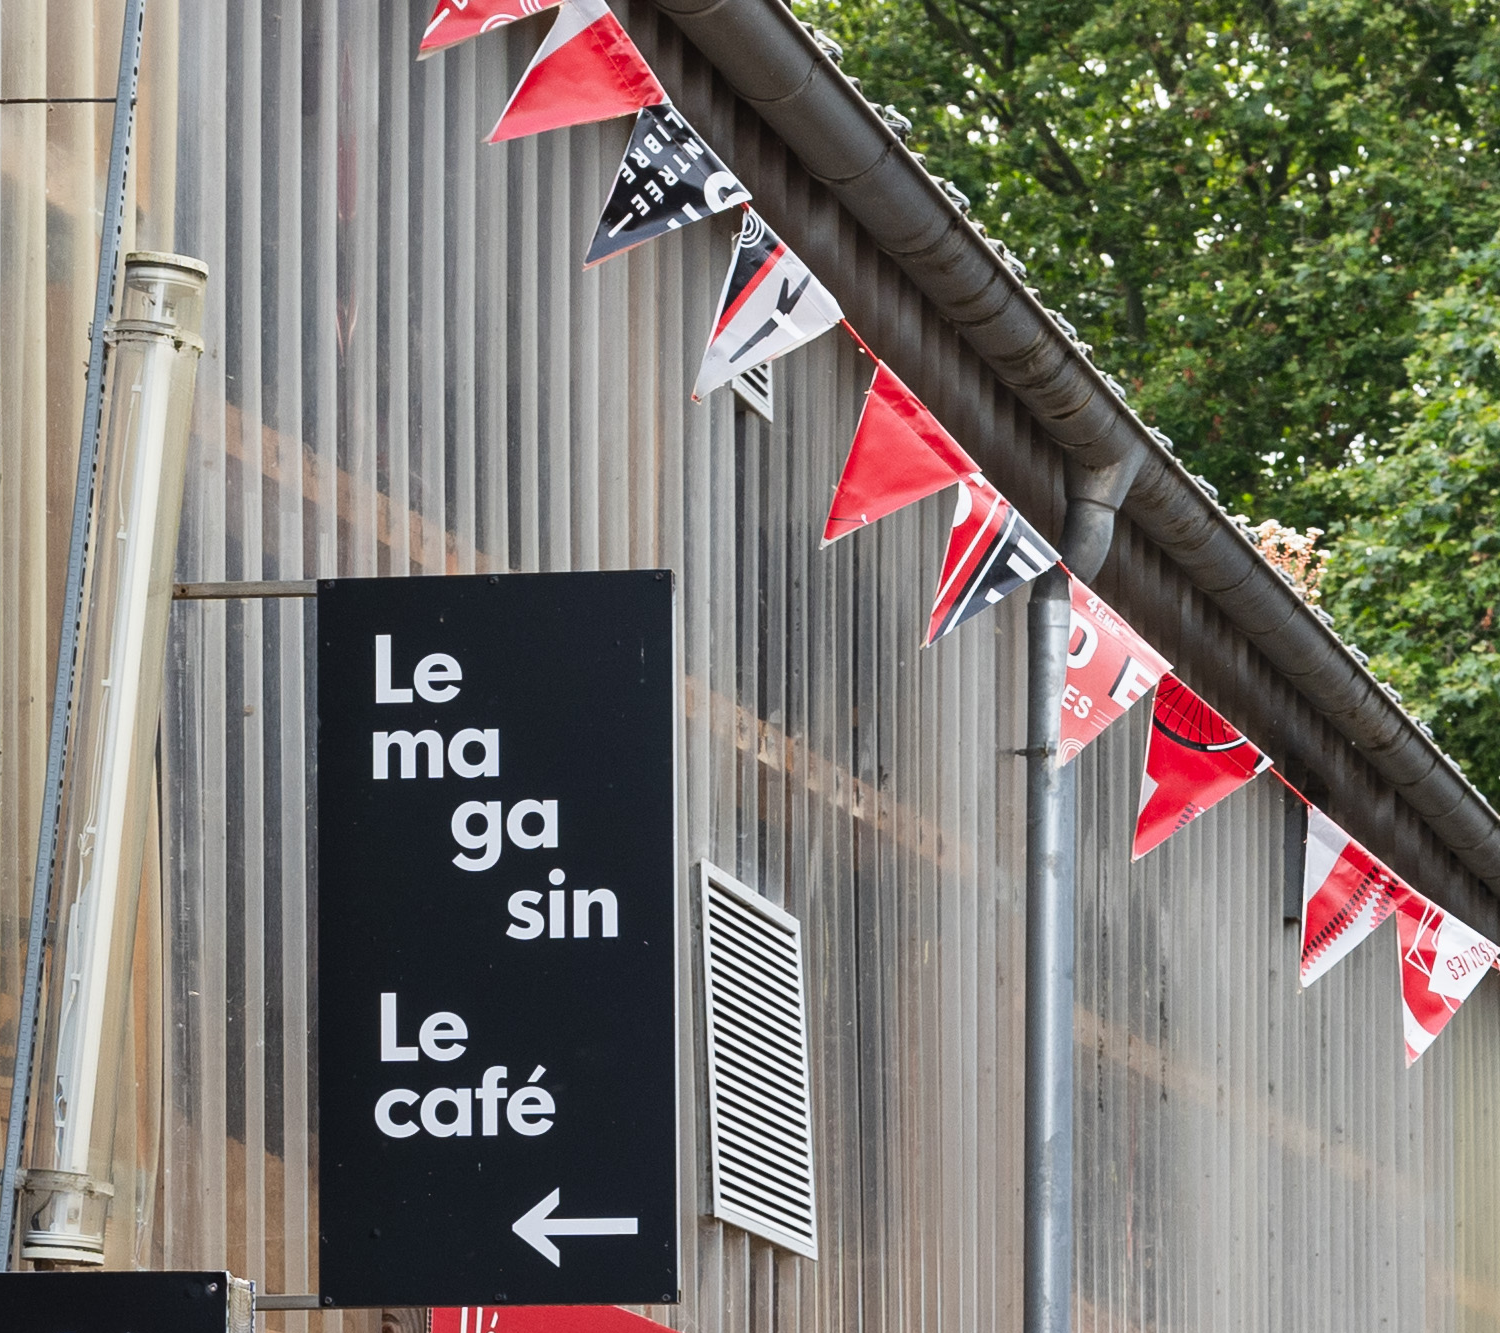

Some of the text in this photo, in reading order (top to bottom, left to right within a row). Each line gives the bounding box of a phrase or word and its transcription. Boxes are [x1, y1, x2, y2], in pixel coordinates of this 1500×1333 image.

[374, 634, 463, 702] Le
[373, 728, 502, 780] ma
[451, 800, 558, 871] ga
[506, 868, 620, 939] sin
[380, 992, 467, 1061] Le
[374, 1065, 557, 1137] café
